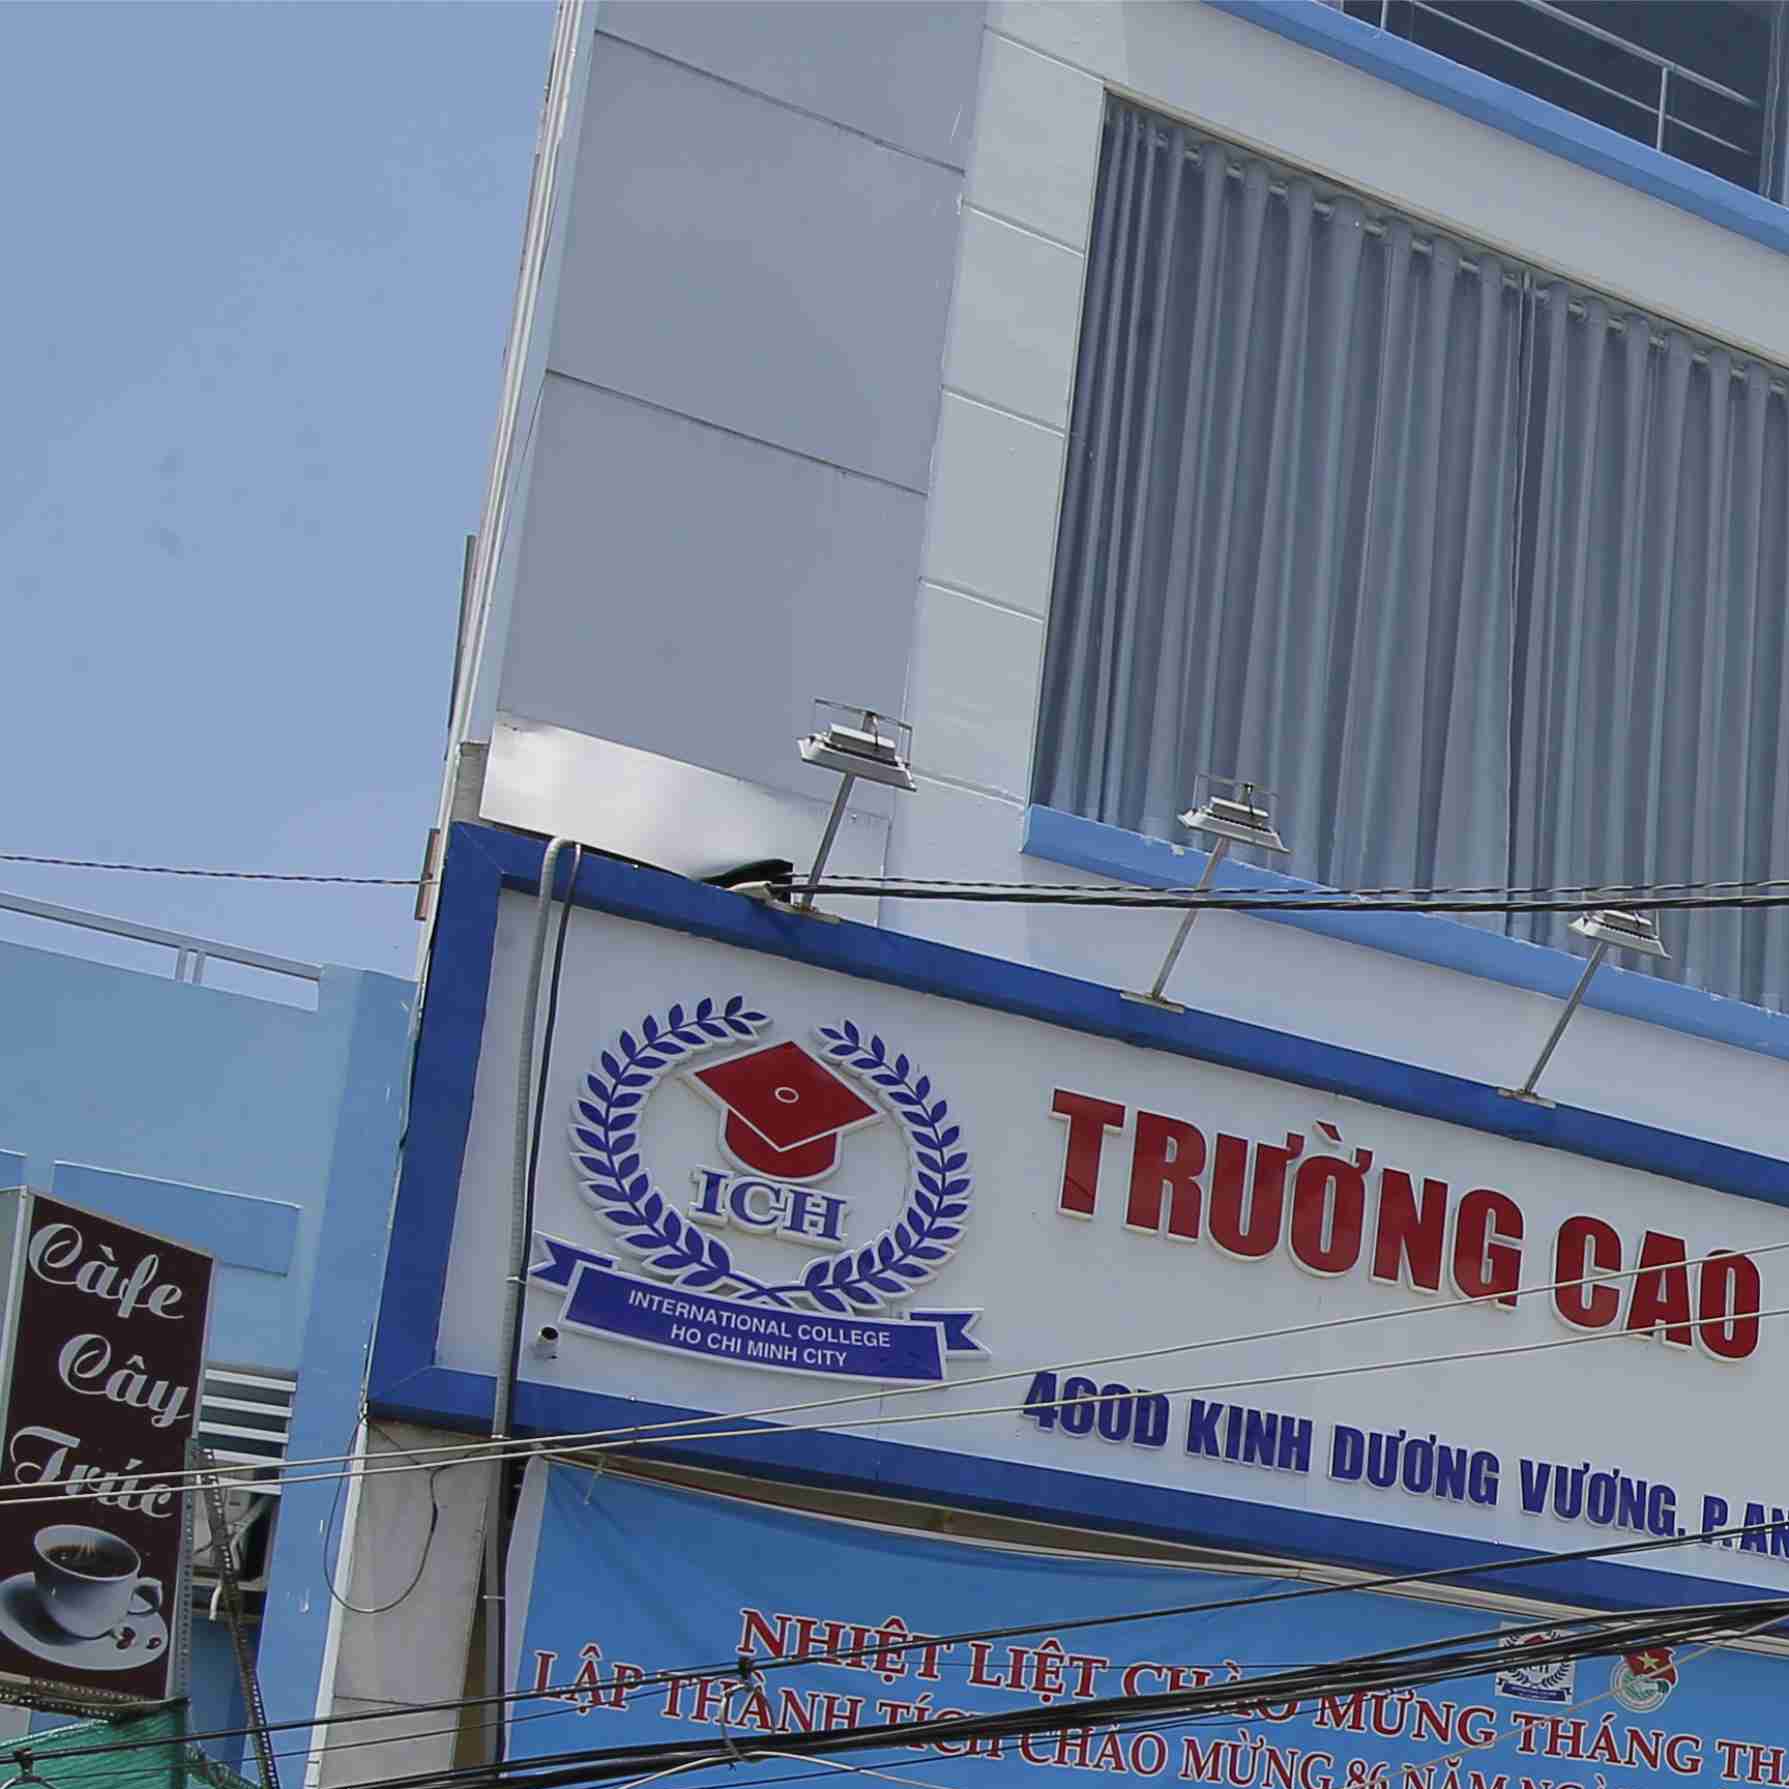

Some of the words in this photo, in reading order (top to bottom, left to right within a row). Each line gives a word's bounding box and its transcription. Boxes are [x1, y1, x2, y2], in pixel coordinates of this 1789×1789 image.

[690, 1168, 846, 1244] ICH
[1050, 1088, 1524, 1309] TRƯỜNG
[1555, 1215, 1761, 1360] CAO
[29, 1223, 184, 1319] Càfe
[628, 1289, 792, 1339] INTERNATIONAL
[798, 1324, 891, 1348] COLLEGE
[58, 1333, 191, 1428] Cây
[671, 1323, 701, 1345] HO
[707, 1331, 741, 1354] CHI
[747, 1340, 798, 1363] MINH
[803, 1347, 848, 1367] CITY
[1023, 1371, 1168, 1449] 460D
[1186, 1397, 1313, 1473] KINH
[1330, 1424, 1500, 1507] DƯƠNG
[533, 1643, 643, 1717] LẬP
[655, 1668, 865, 1738] THÀNH
[737, 1607, 953, 1684] NHIỆT
[967, 1638, 1108, 1704] LIỆT
[1121, 1658, 1300, 1724] CHO
[1511, 1711, 1703, 1778] THÁNG
